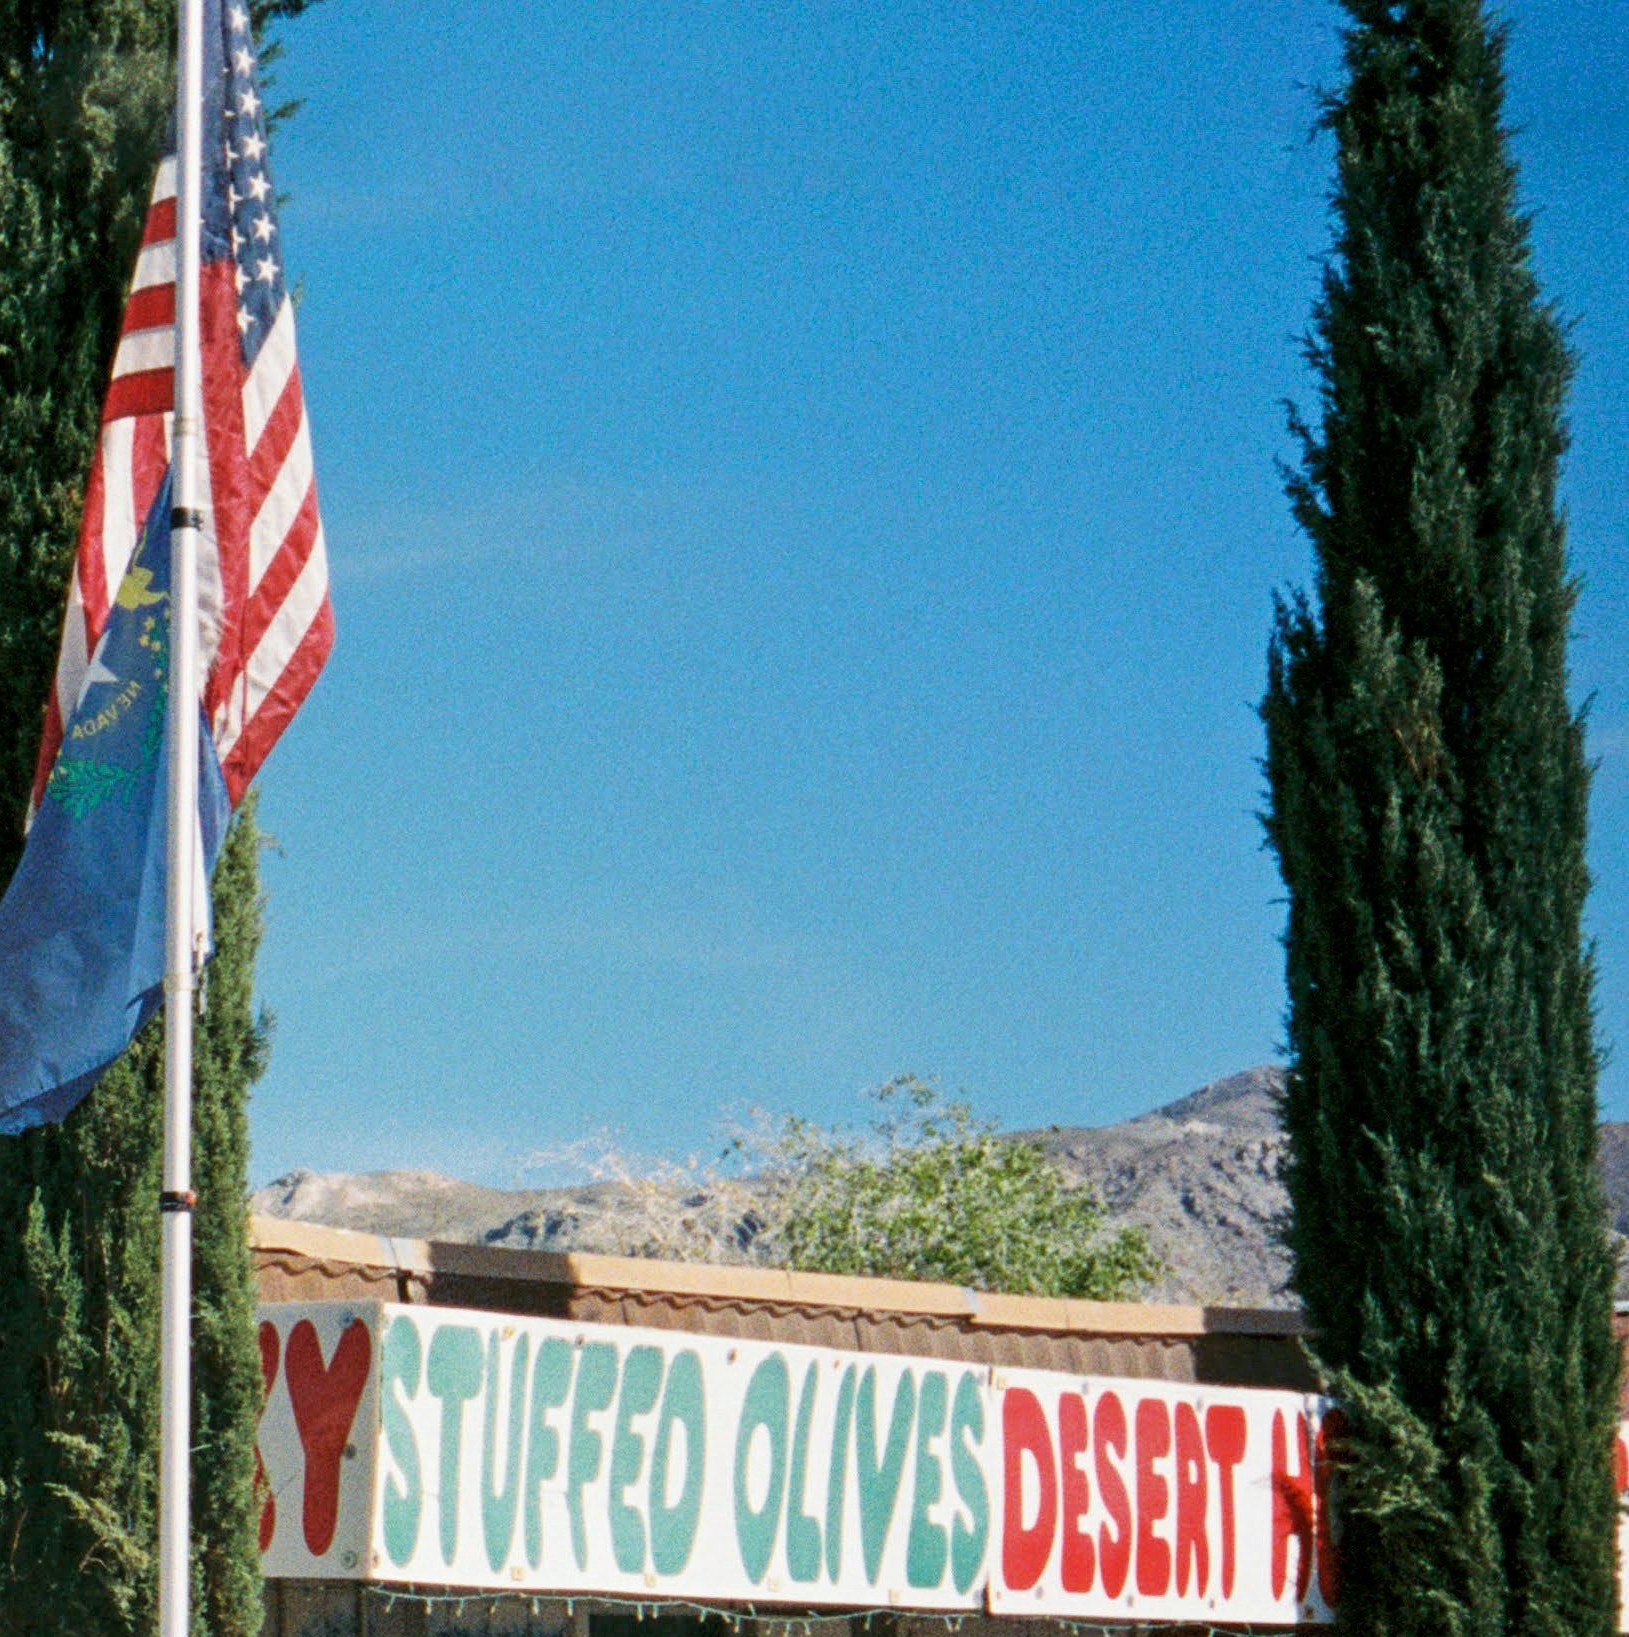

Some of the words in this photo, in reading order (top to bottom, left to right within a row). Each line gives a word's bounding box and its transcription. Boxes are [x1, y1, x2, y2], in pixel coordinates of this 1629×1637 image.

[381, 1315, 706, 1577] STUFFED
[733, 1350, 991, 1596] OLIVES
[1002, 1387, 1247, 1601] DESERT
